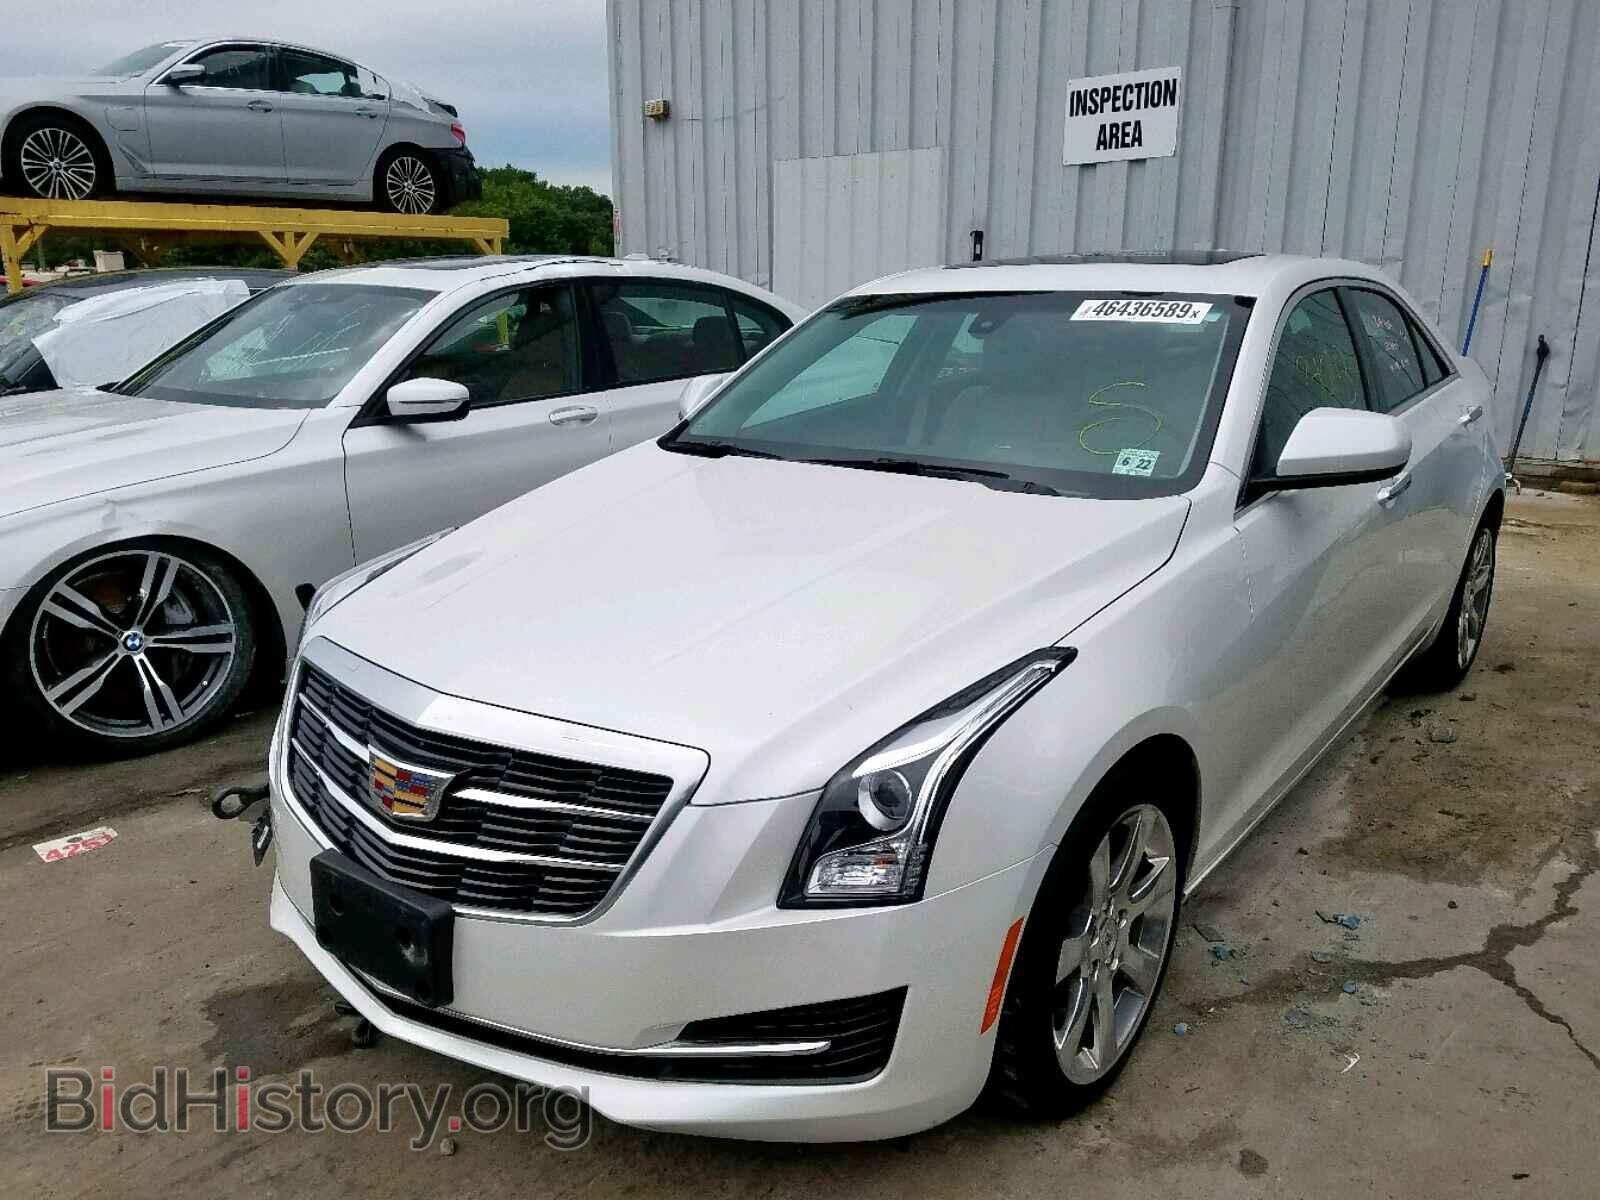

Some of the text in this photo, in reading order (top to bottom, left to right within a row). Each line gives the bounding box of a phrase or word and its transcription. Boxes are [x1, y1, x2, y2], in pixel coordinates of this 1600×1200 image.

[1069, 78, 1177, 117] INSPECTION
[1096, 119, 1143, 151] AREA
[1122, 456, 1152, 470] 6 22
